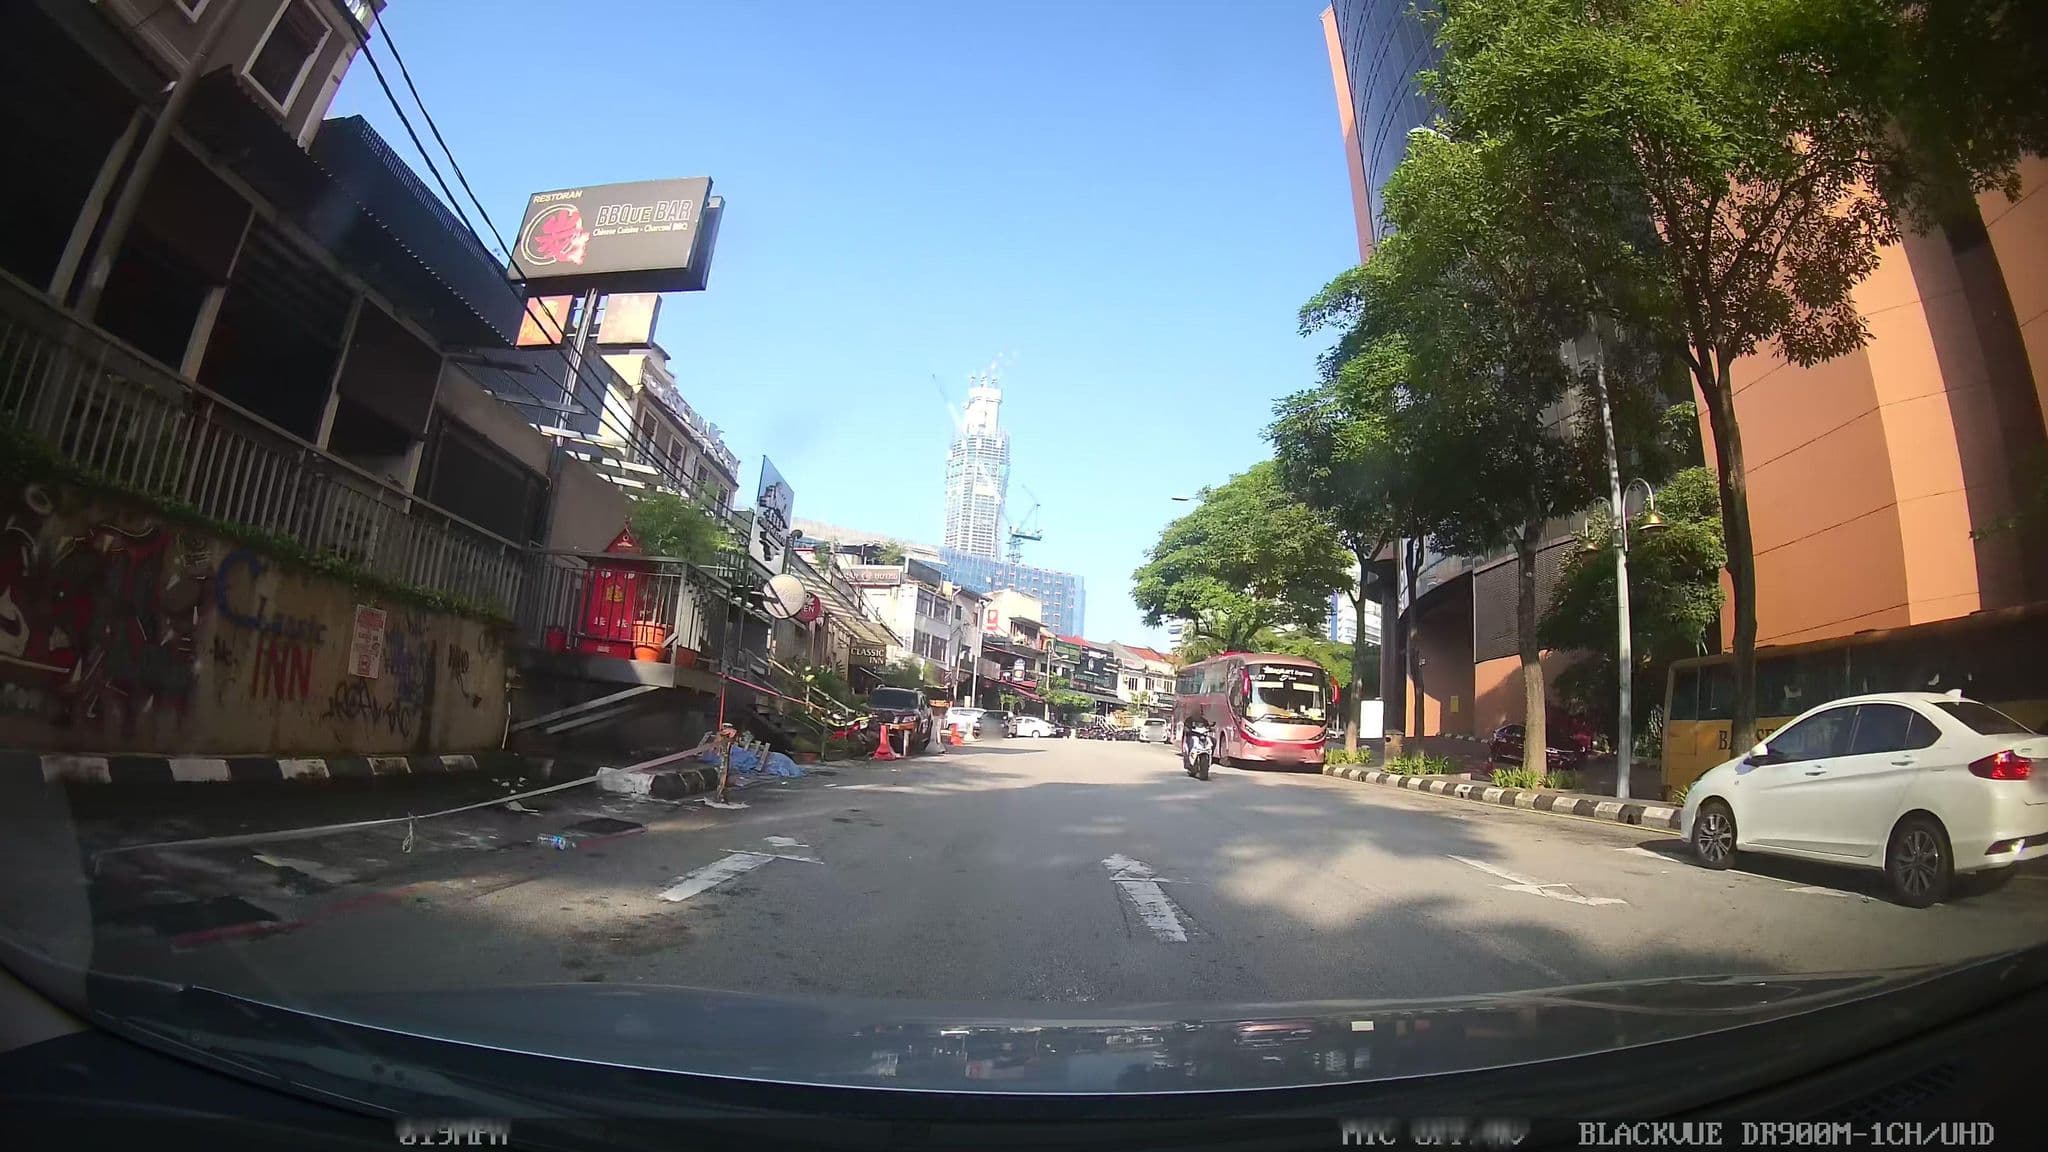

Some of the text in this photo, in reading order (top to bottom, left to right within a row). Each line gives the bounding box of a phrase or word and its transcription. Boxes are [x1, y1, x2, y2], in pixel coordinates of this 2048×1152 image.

[533, 190, 583, 203] RESTORAN
[653, 200, 693, 221] BAR
[592, 223, 688, 236] Chinese Cuisine Charcoal BBQ
[850, 647, 885, 657] CLASSIC
[869, 656, 885, 664] INN
